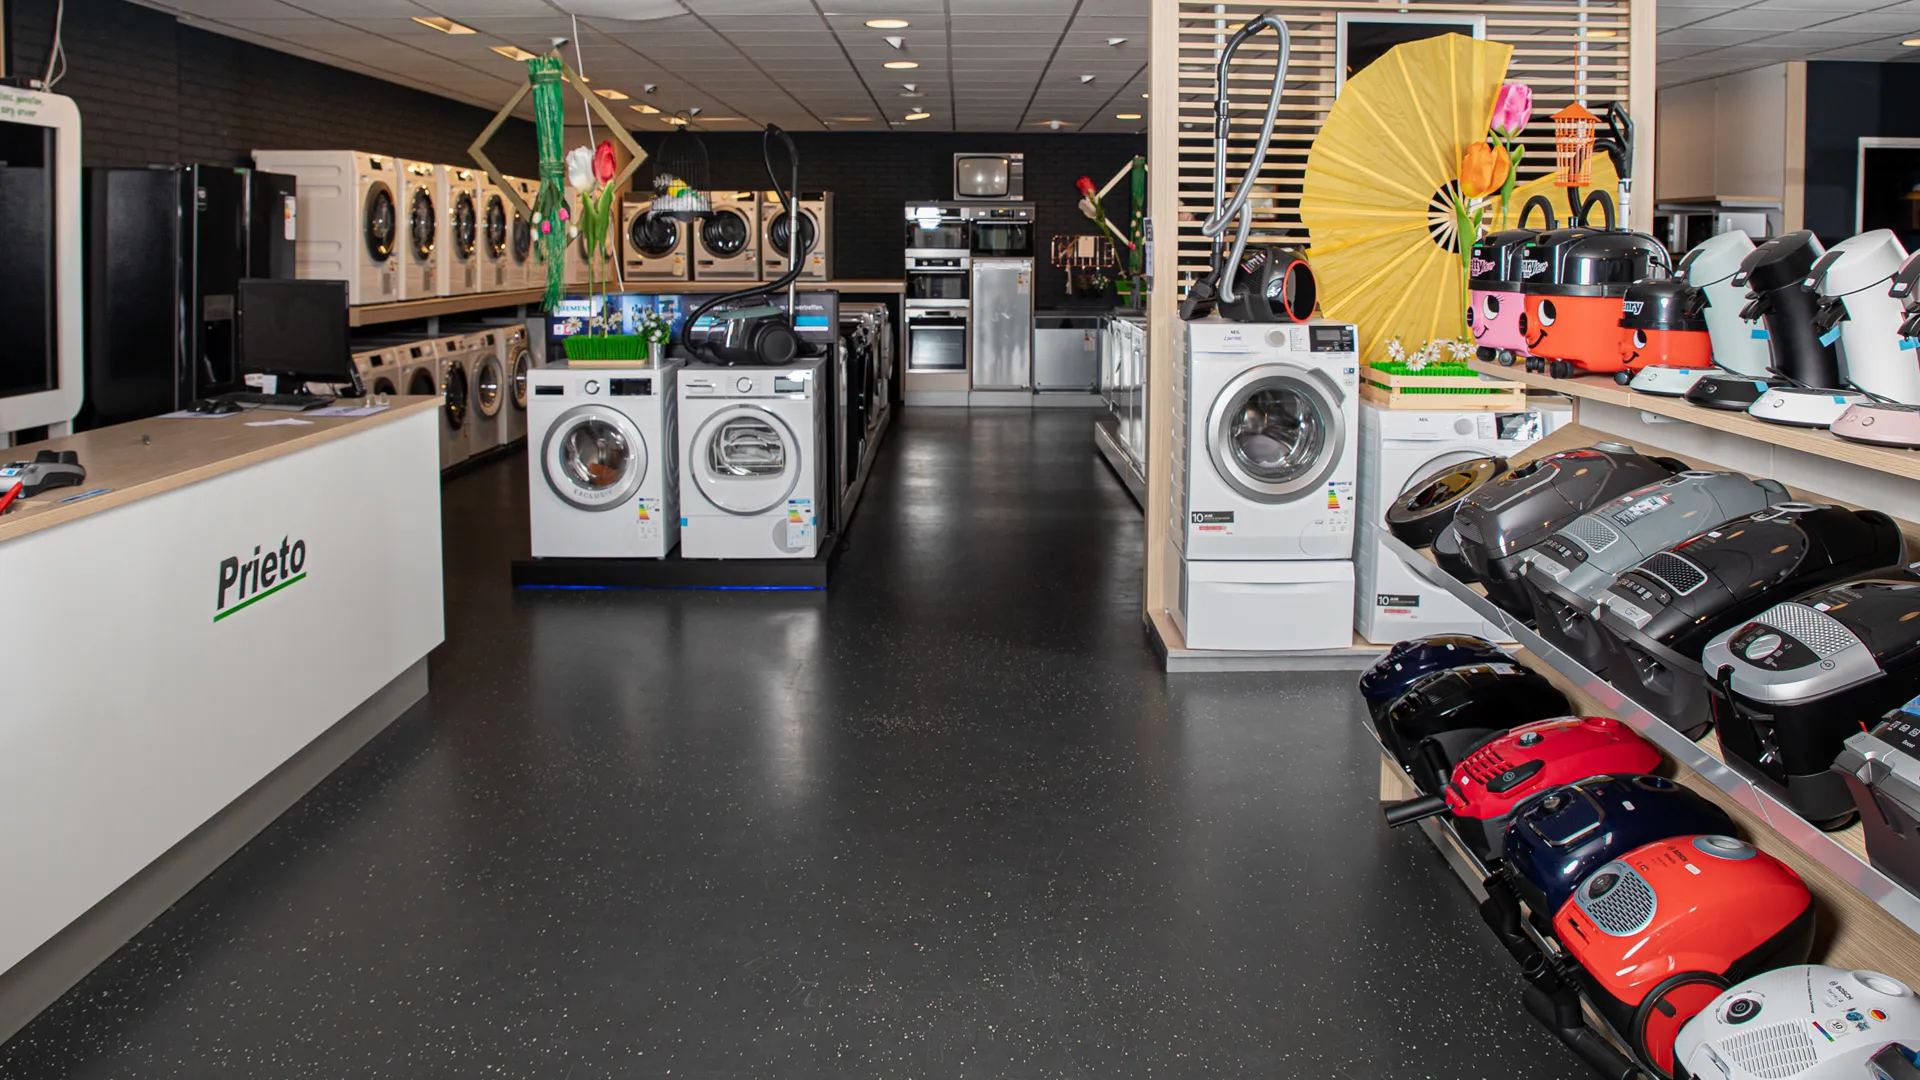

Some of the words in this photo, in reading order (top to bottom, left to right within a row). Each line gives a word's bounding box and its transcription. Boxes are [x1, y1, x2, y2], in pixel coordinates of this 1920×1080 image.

[1623, 302, 1643, 315] enry
[1192, 513, 1204, 523] 10
[216, 534, 306, 611] Prieto
[1378, 596, 1389, 605] 10
[1835, 985, 1854, 1000] BOSCH
